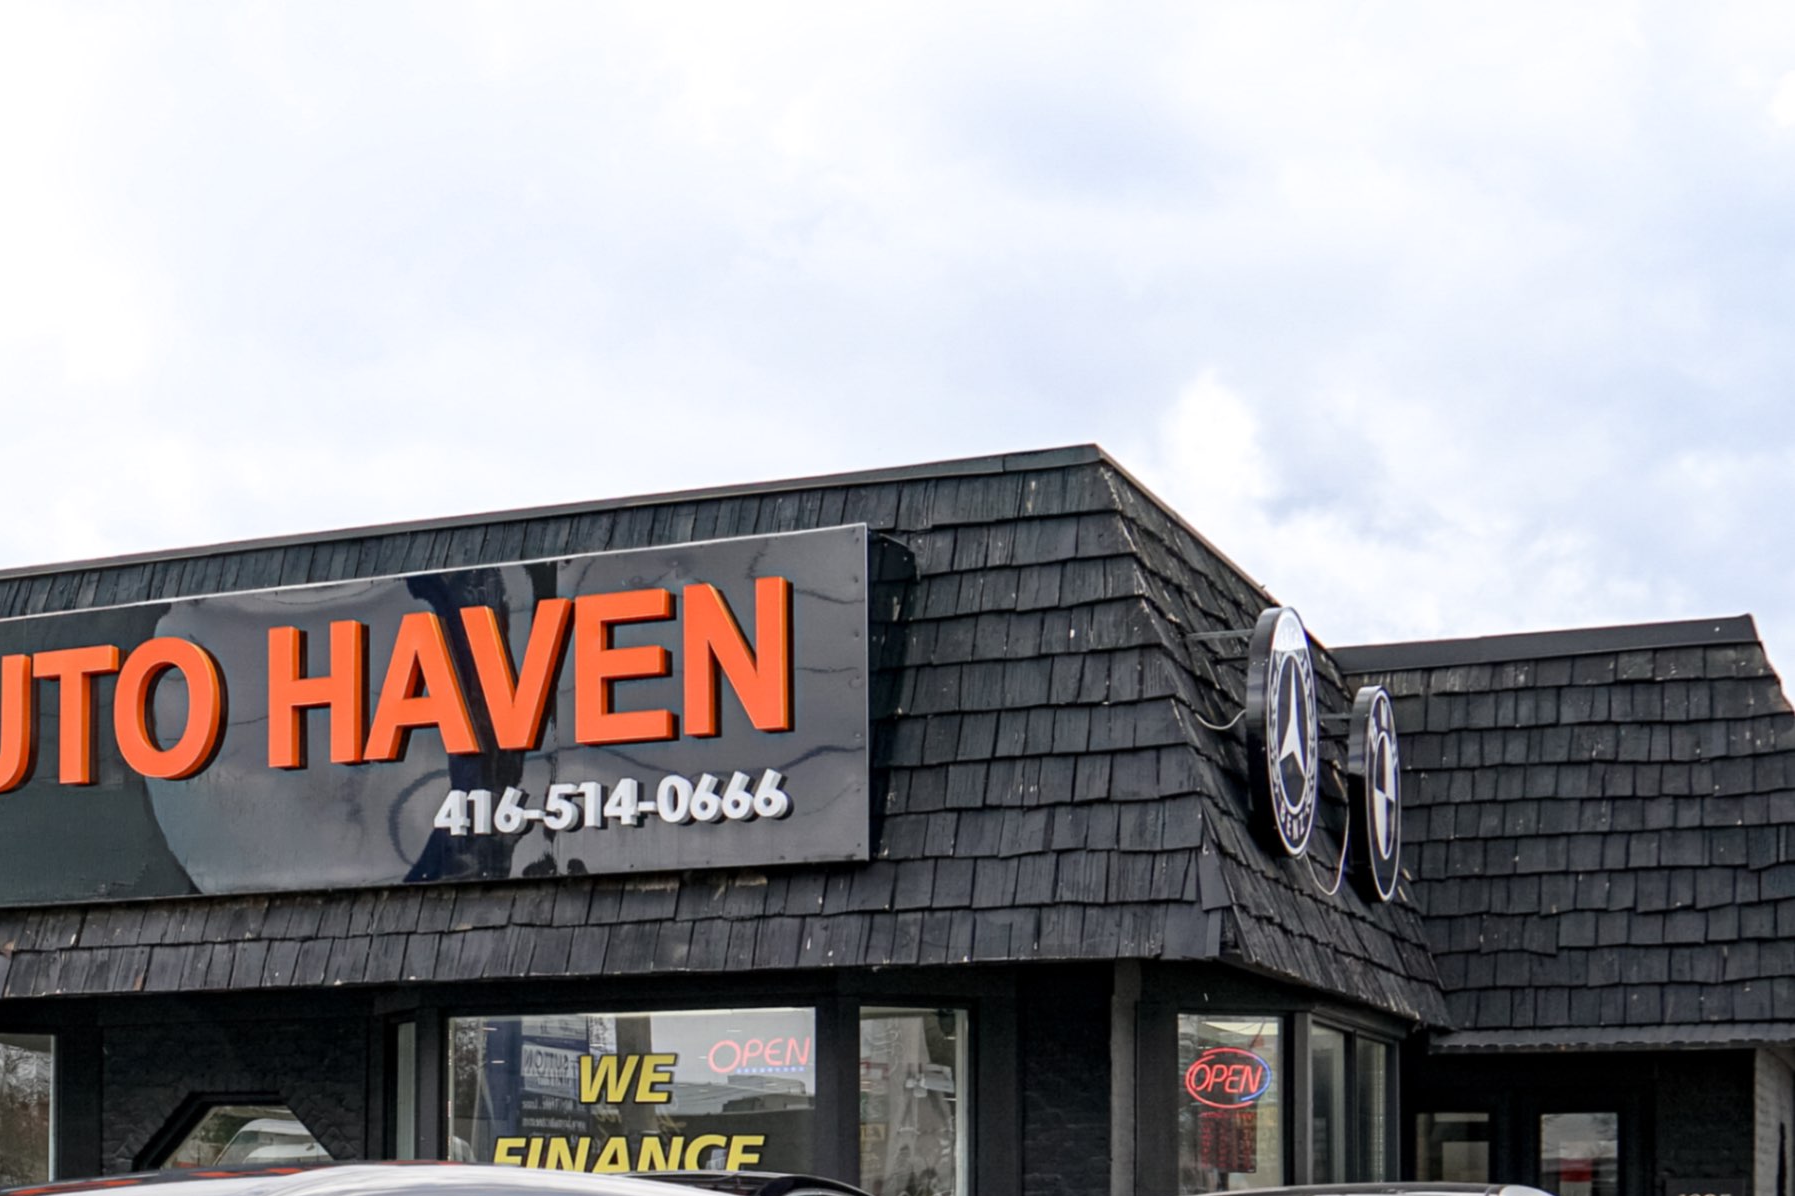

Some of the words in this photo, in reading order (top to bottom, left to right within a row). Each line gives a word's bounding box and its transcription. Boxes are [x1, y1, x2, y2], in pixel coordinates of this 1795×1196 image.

[268, 576, 793, 769] HAVEN
[433, 768, 791, 836] 416-514-0666
[1278, 799, 1305, 842] BENZ
[707, 1035, 811, 1073] OPEN
[579, 1053, 678, 1104] WE
[1190, 1063, 1263, 1093] OPEN
[494, 1135, 765, 1173] FINANCE
